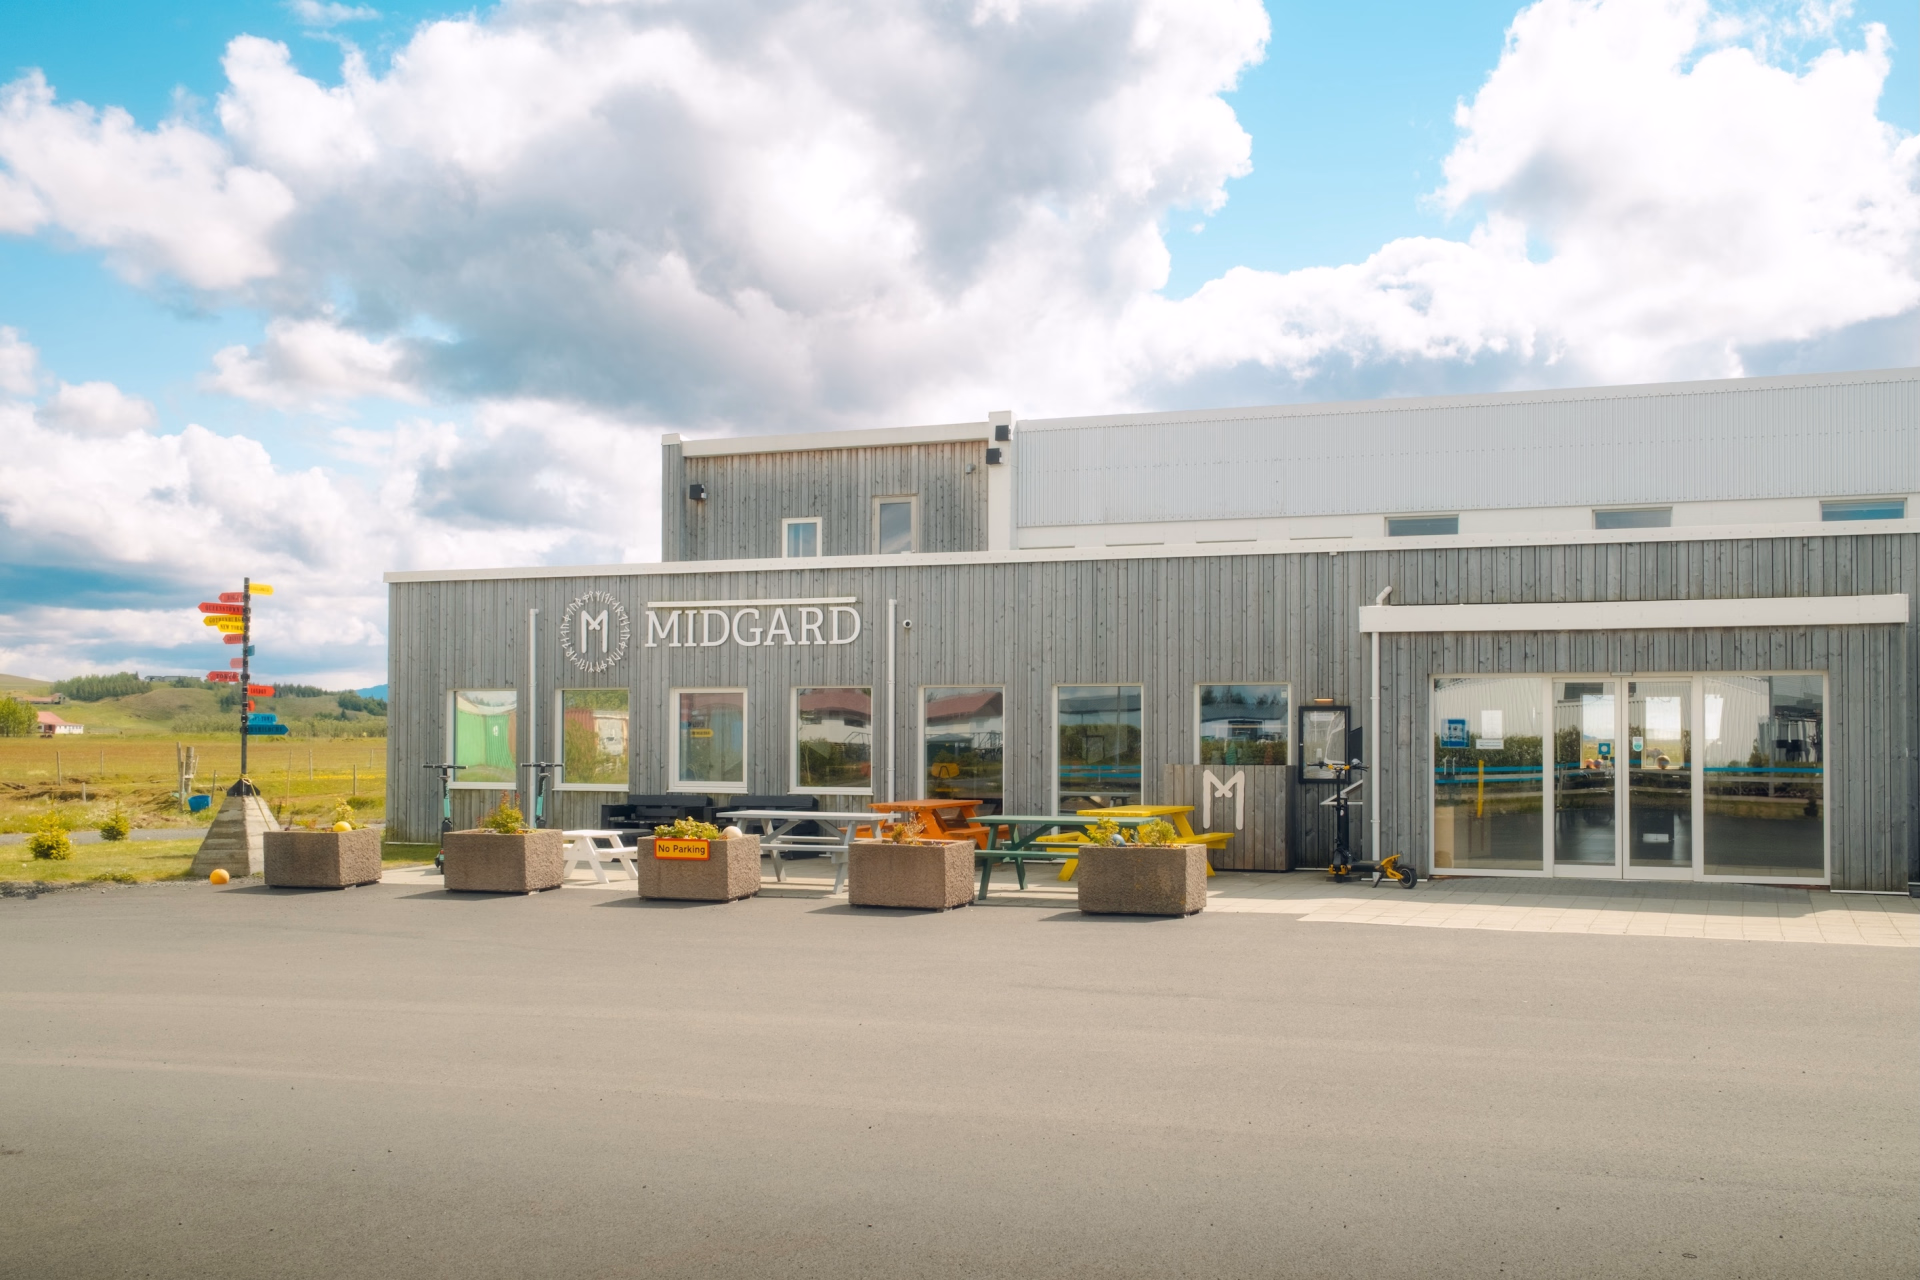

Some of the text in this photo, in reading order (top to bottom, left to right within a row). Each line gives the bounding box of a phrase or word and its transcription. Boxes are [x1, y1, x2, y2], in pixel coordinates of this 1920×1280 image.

[205, 604, 240, 612] QUEENSTOWN
[645, 606, 861, 647] MIDGARD
[658, 844, 705, 855] No Parking
